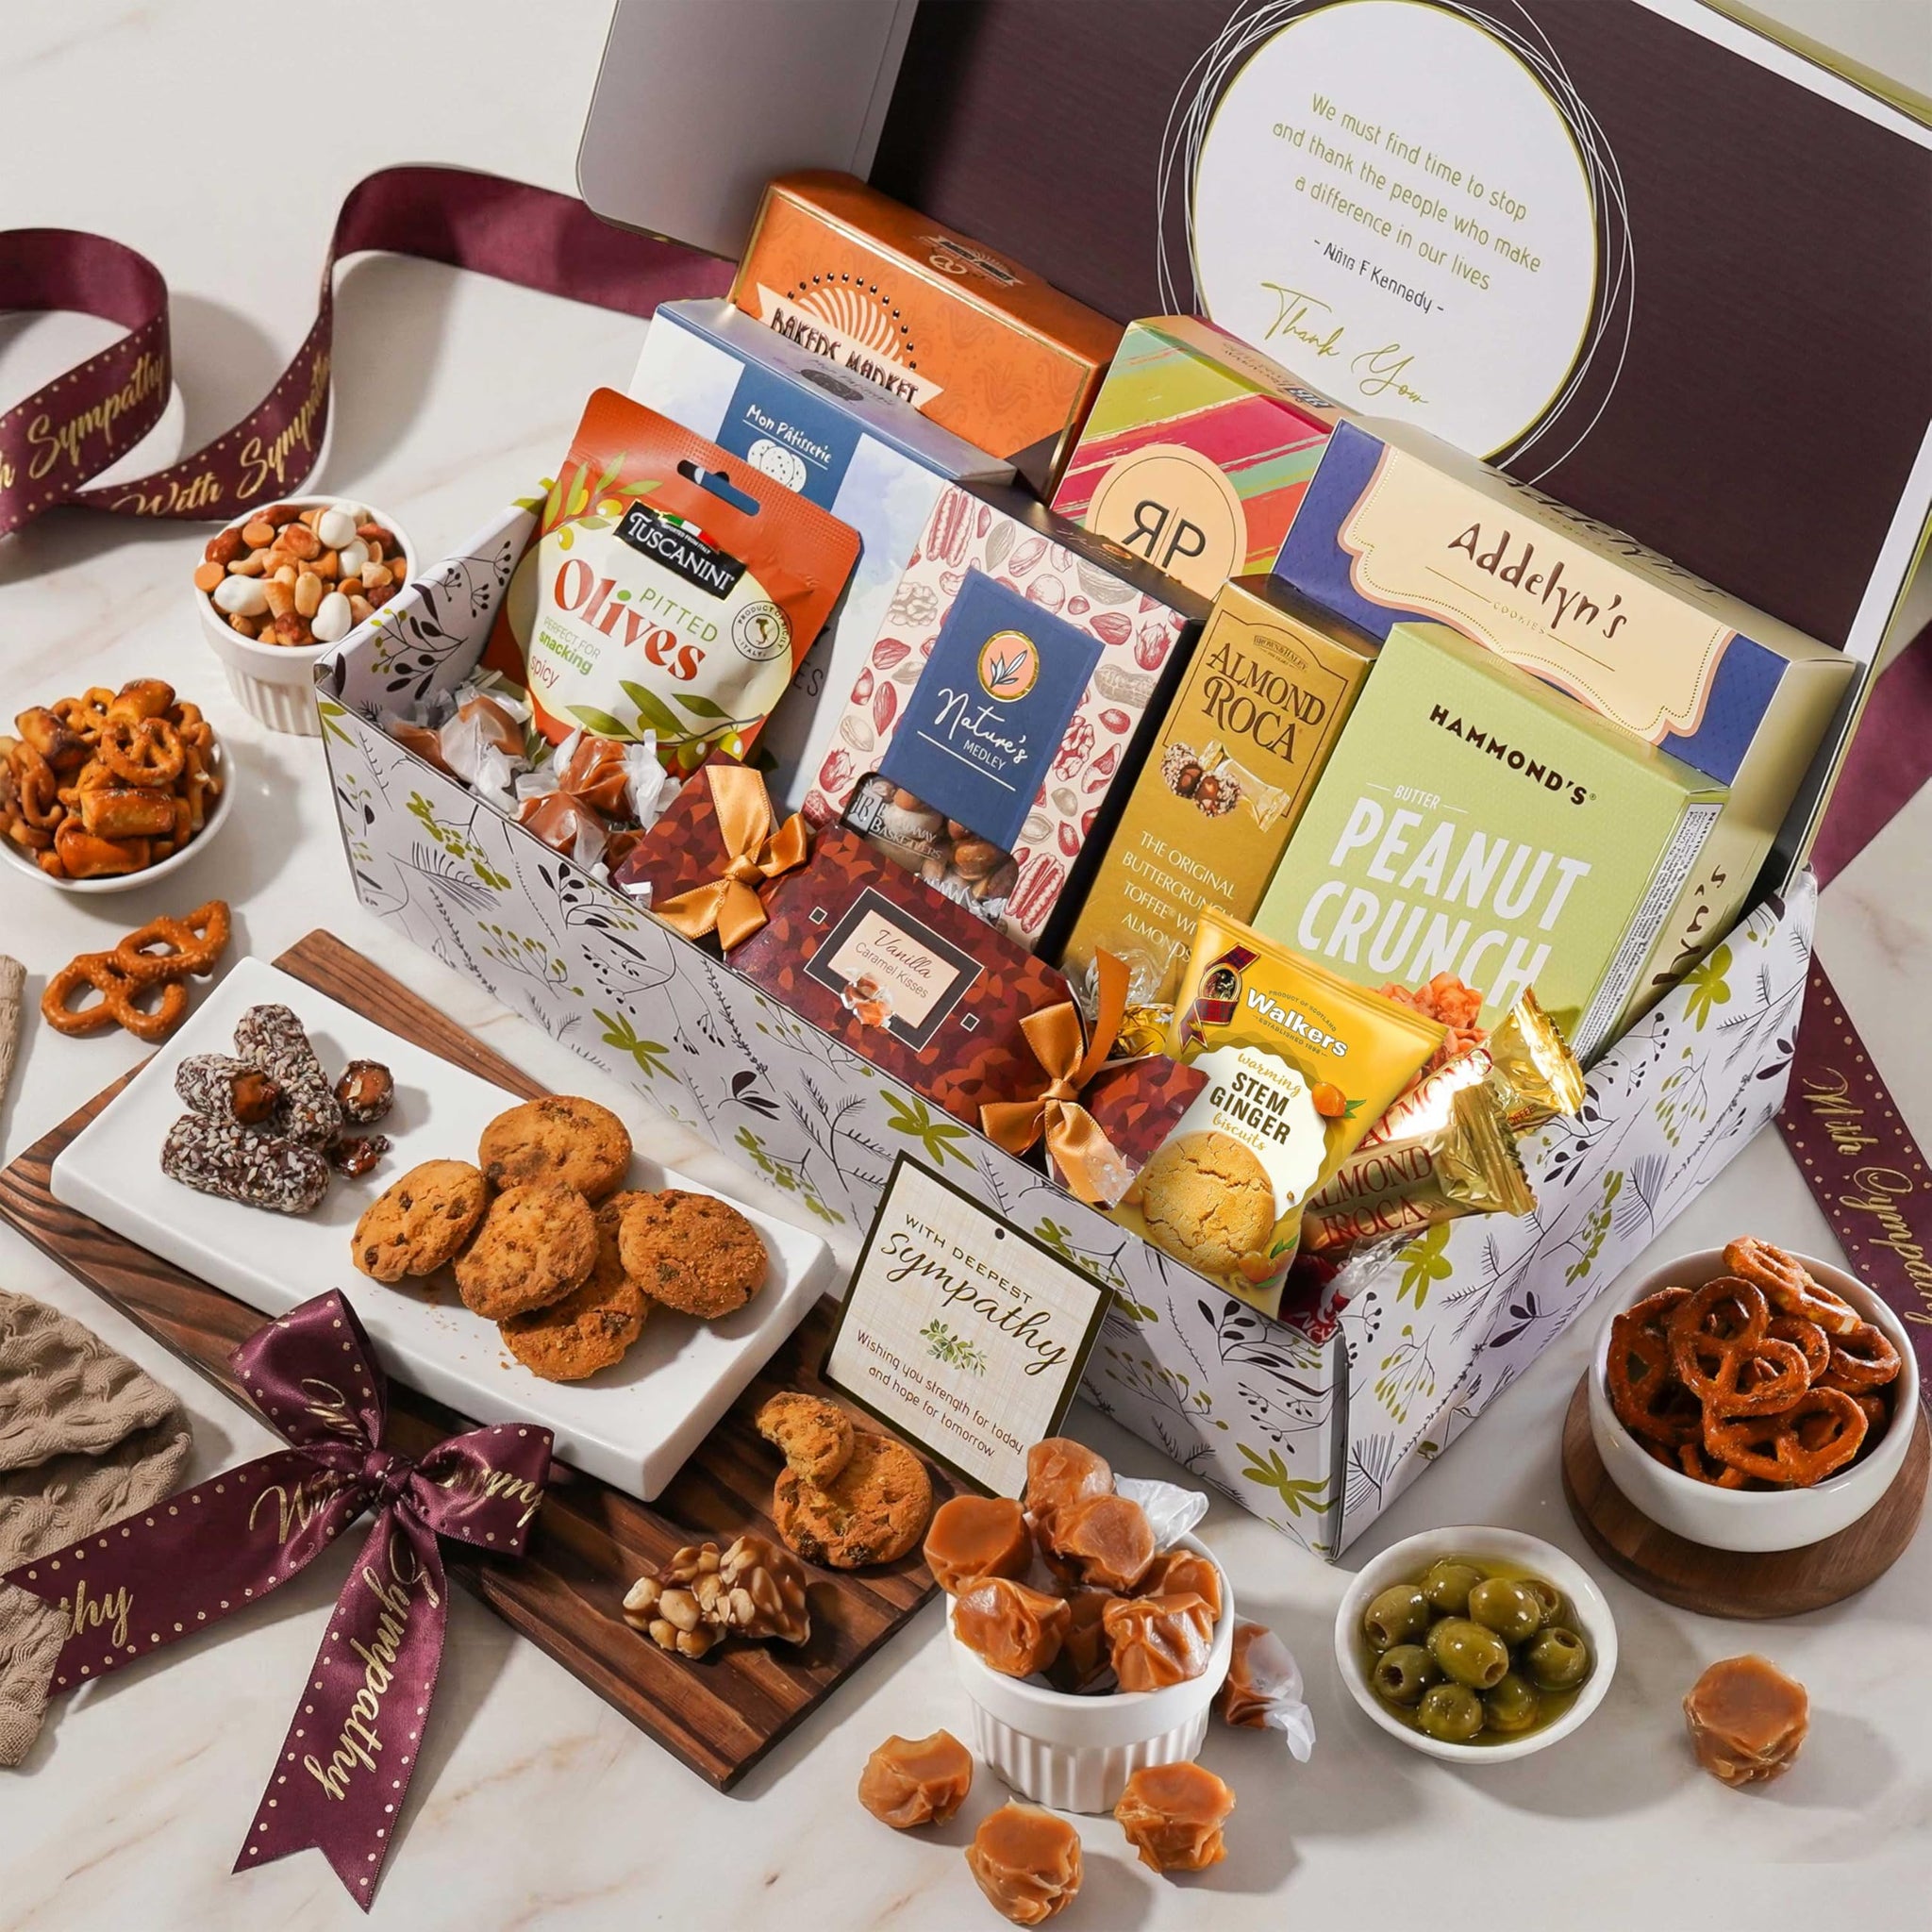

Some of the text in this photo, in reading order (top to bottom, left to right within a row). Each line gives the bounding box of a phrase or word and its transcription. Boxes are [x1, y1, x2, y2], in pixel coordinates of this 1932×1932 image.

[1311, 92, 1527, 222] We must find time to stop
[1273, 122, 1541, 273] and thank the people who make
[1294, 175, 1491, 291] a difference in our lives
[1359, 259, 1371, 275] F
[1371, 266, 1433, 314] Kennedy
[1260, 282, 1344, 357] Thank
[1351, 343, 1429, 404] You
[27, 352, 165, 479] Sympathy
[746, 404, 832, 463] Mon Pâtisserie
[110, 472, 223, 516] With
[628, 511, 733, 591] TUSCANINI
[1447, 522, 1628, 640] Addelyn's
[543, 616, 601, 659] PERFECT FOR
[554, 558, 707, 681] Olives
[640, 587, 719, 643] PITTED
[738, 605, 774, 625] PRODUCT
[1492, 601, 1547, 636] COOKIES
[530, 656, 560, 690] spicy
[539, 630, 593, 676] snacking
[1206, 642, 1326, 725] ALMOND
[934, 688, 1028, 764] Nature's
[1202, 675, 1296, 764] ROCA
[963, 739, 1008, 771] MEDLEY
[1429, 704, 1588, 805] HAMMOND'S
[1393, 784, 1441, 810] BUTTER
[1123, 851, 1234, 918] BUTTERCRUN
[1141, 830, 1235, 900] THE ORIGINAL
[1328, 796, 1592, 932] PEANUT
[874, 929, 933, 979] Vanilla
[1175, 913, 1197, 936] WI
[1297, 880, 1553, 1008] CRUNCH
[855, 941, 929, 999] Caramel Kisses
[1268, 990, 1299, 1003] PRODUCT
[1246, 987, 1349, 1058] Walkers
[1231, 1072, 1290, 1116] STEM
[1238, 1053, 1302, 1098] warming
[1209, 1086, 1291, 1145] GINGER
[1212, 1111, 1266, 1151] biscuits
[1802, 1066, 1878, 1156] With
[905, 1214, 1033, 1305] WITH DEEPEST
[857, 1328, 1024, 1456] Wishing you strength for today
[868, 1366, 891, 1386] and
[891, 1377, 921, 1407] hope
[922, 1400, 940, 1418] for
